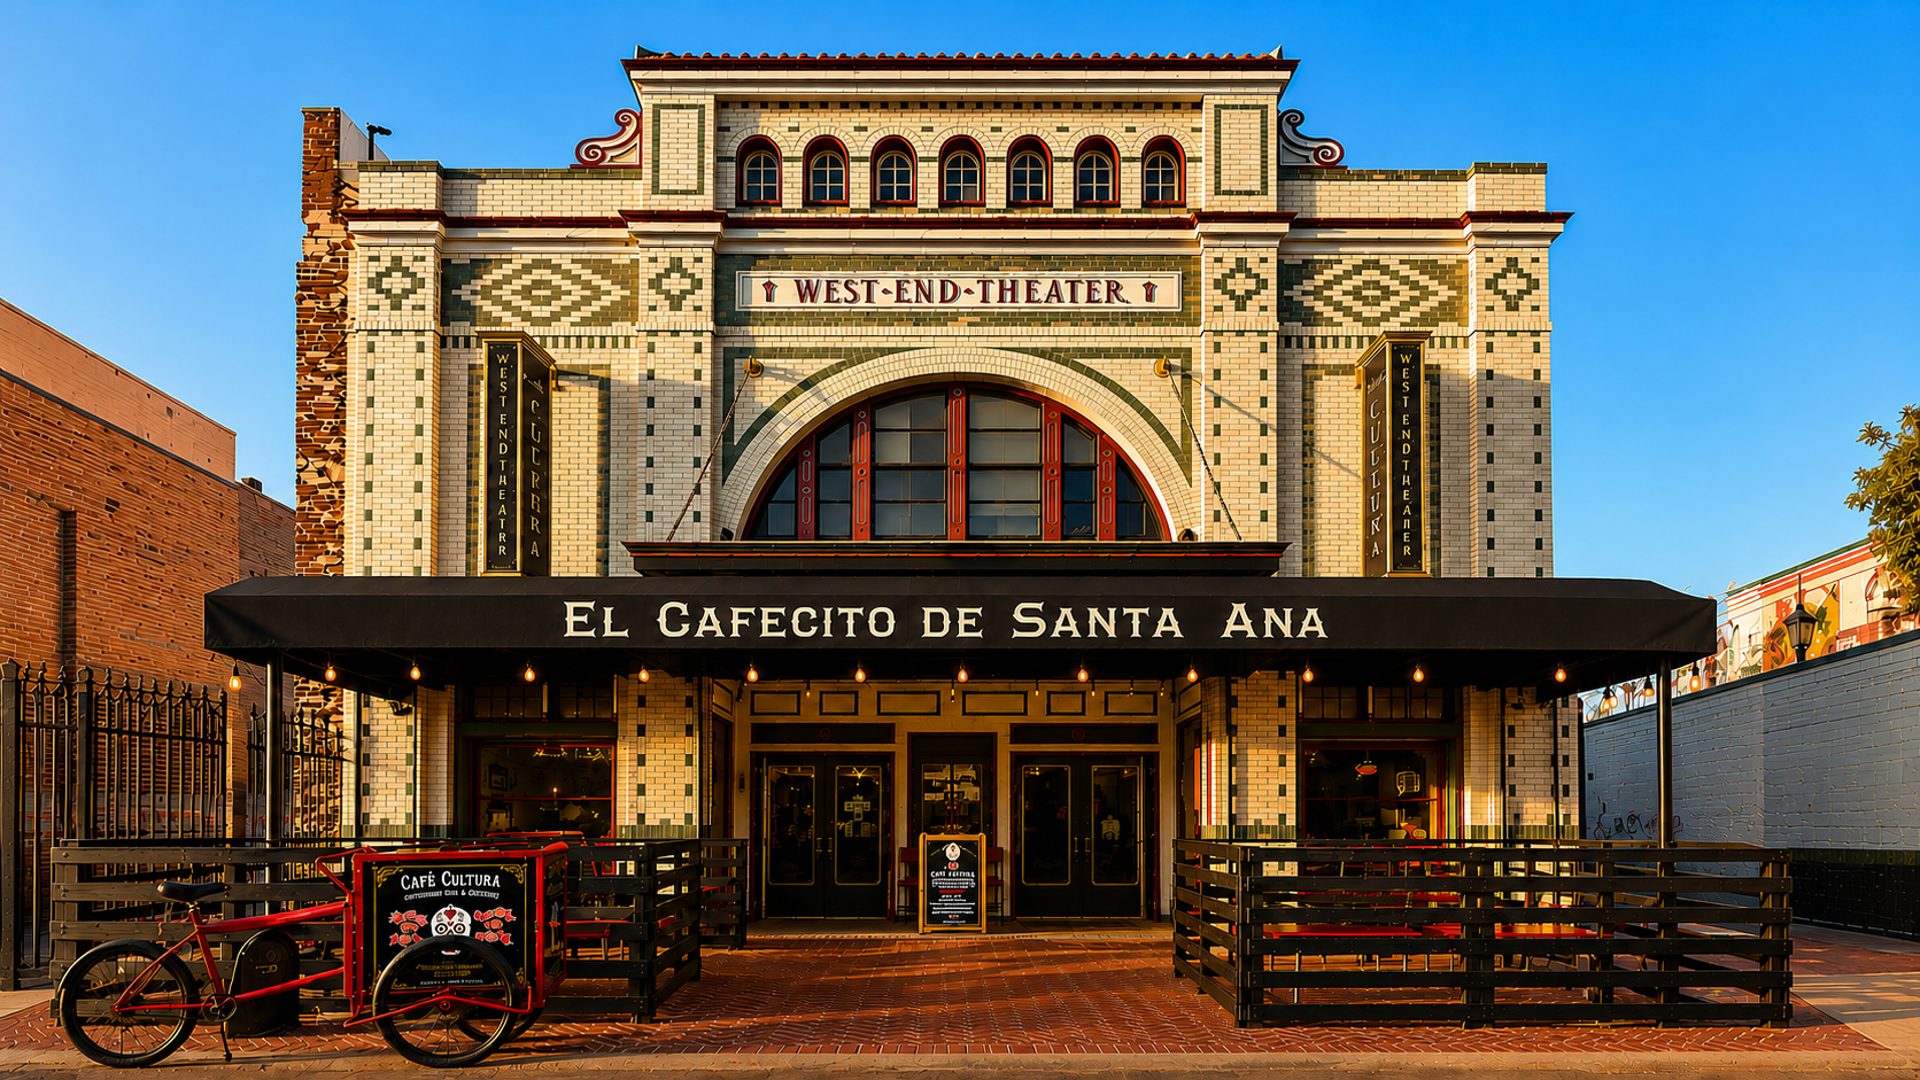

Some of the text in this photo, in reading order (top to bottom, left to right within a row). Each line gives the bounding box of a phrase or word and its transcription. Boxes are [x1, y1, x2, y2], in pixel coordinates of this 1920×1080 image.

[794, 279, 1131, 304] WEST END THEATER
[563, 600, 1328, 639] EL CAFECITO DE SANTA ANA
[401, 870, 501, 890] CAFÉ CULTURA
